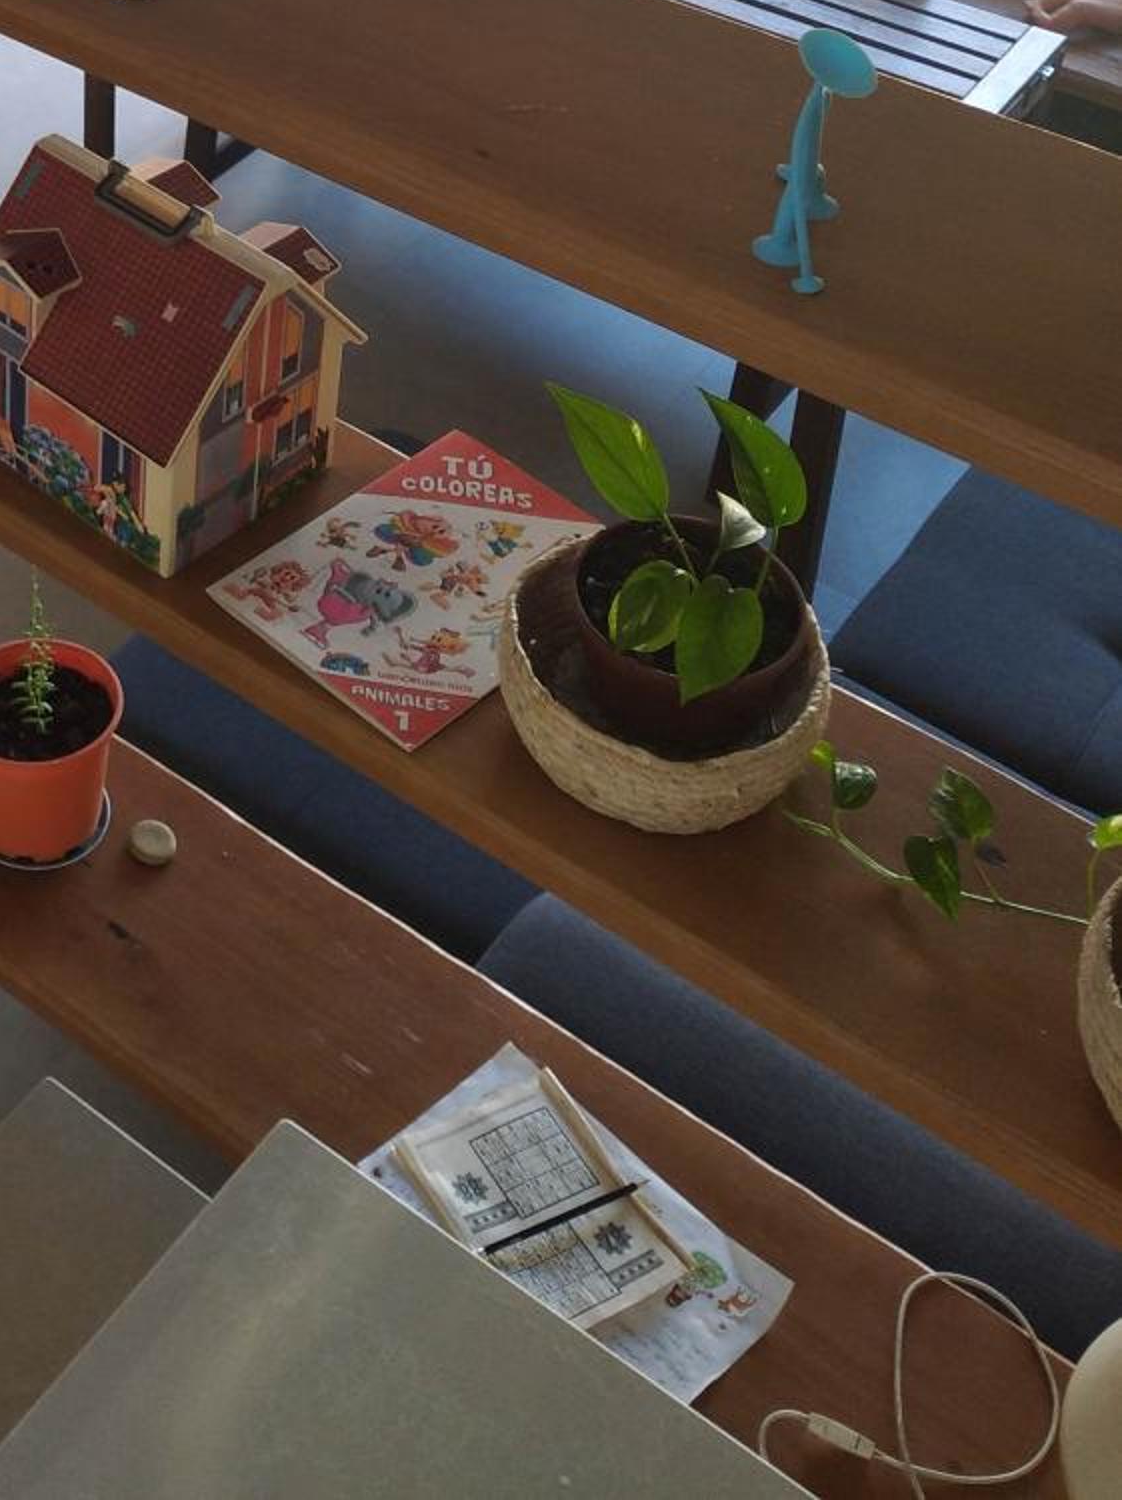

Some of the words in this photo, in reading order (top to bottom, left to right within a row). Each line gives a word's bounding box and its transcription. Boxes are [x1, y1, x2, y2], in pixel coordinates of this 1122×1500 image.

[441, 454, 494, 481] TÚ
[401, 475, 534, 510] COLOREAS
[350, 684, 452, 712] ANIMALES
